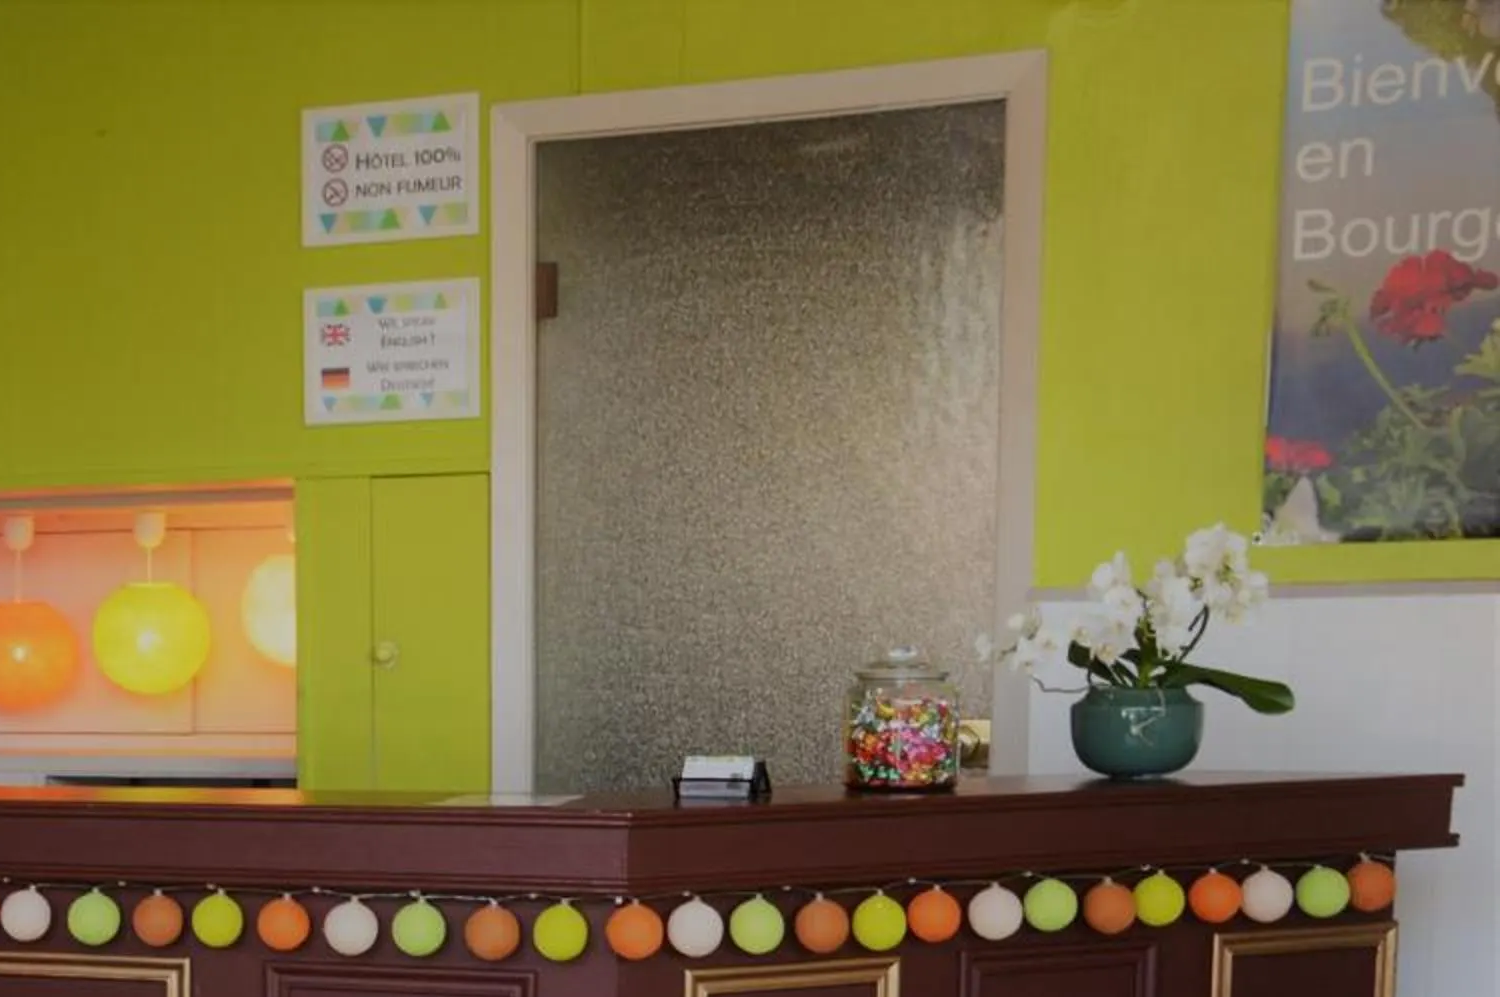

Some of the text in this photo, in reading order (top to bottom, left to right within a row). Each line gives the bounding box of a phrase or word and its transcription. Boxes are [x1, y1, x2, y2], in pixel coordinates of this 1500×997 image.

[414, 146, 462, 166] 100%
[1296, 137, 1374, 182] en
[355, 175, 463, 198] NON FUMEUR
